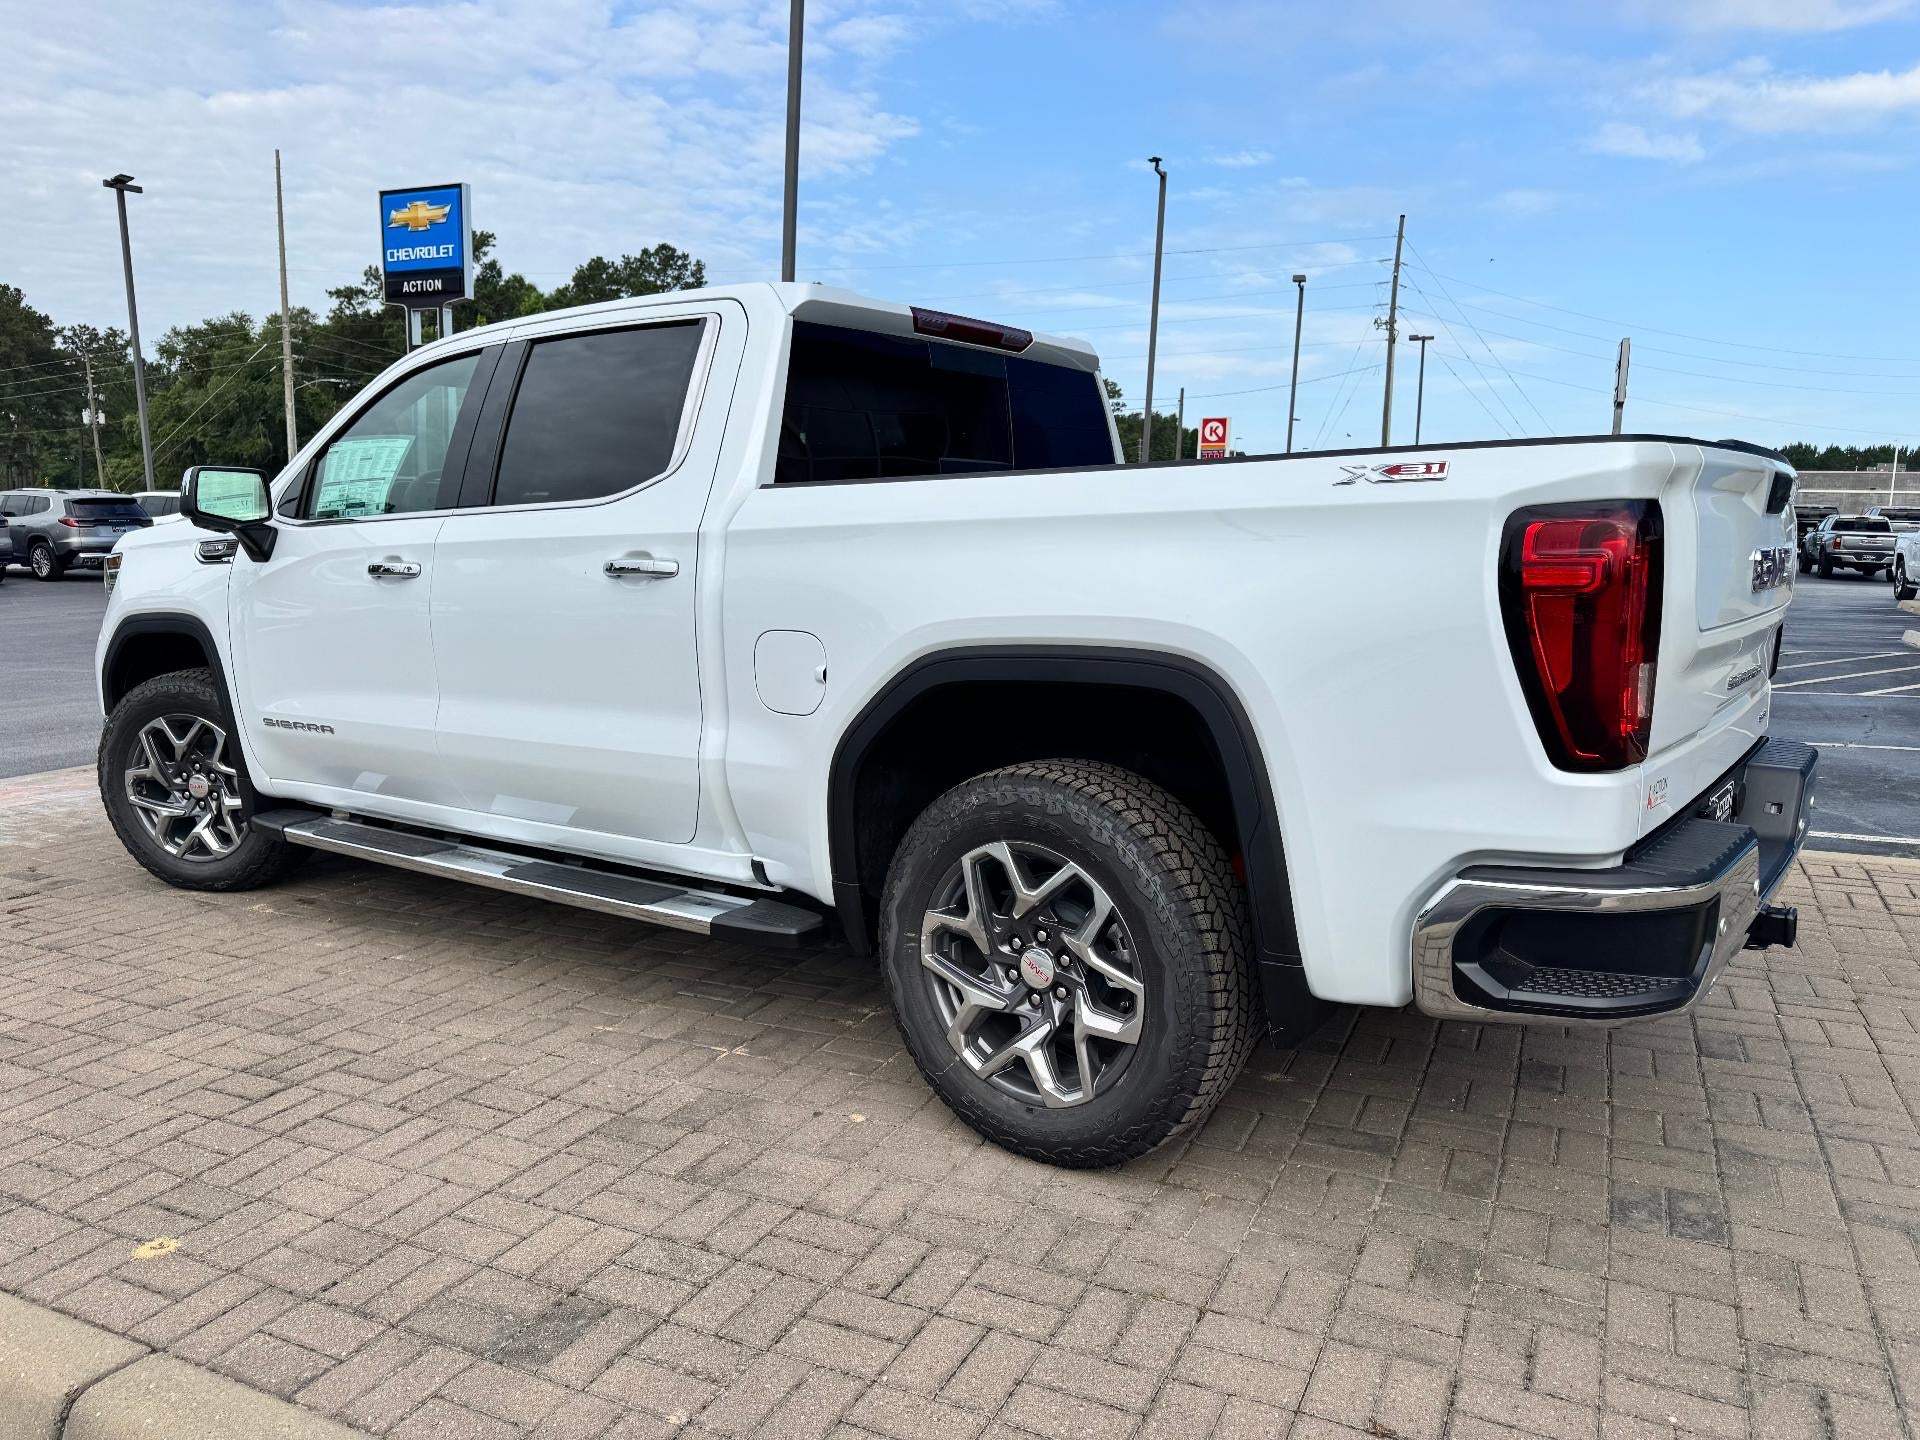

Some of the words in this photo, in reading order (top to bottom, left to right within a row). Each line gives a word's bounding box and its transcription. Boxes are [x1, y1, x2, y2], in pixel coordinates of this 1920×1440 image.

[386, 244, 455, 262] CHEVROLET
[402, 279, 442, 293] ACTION
[1331, 460, 1450, 487] X31
[262, 717, 335, 735] SIERRA
[1023, 954, 1050, 983] GMC
